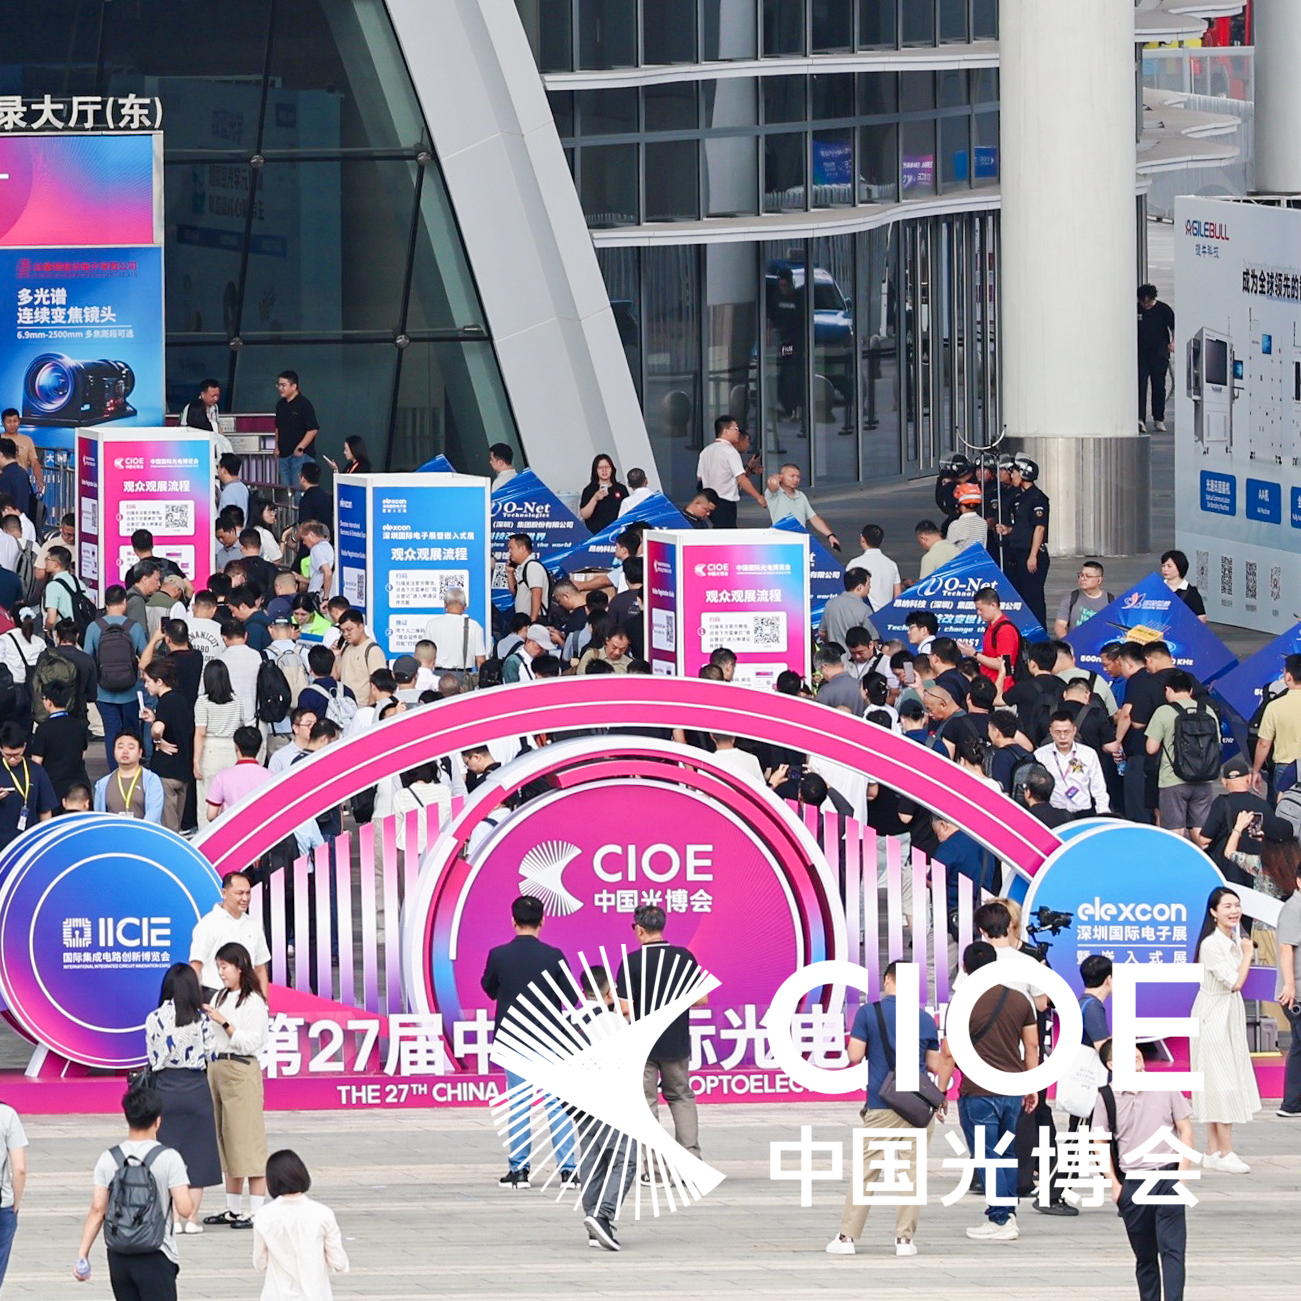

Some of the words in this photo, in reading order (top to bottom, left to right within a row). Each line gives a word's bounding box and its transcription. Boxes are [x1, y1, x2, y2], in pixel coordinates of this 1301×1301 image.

[17, 287, 67, 306] 多光谱
[17, 306, 117, 325] 连续变焦镜头
[123, 480, 190, 492] 观众观展流程
[503, 501, 551, 514] O-Net
[391, 547, 468, 561] 观众观展流程
[707, 563, 729, 572] CIOE
[944, 577, 998, 592] O-Net
[705, 589, 782, 603] 观众观展流程
[593, 843, 714, 883] CIOE
[593, 889, 713, 914] 中国光博会
[1077, 897, 1187, 922] elexcon
[98, 917, 171, 947] IICIE
[1076, 926, 1187, 941] 深圳国际电子展
[63, 951, 171, 963] 国际集成电路创新博览会
[337, 1084, 381, 1105] THE
[432, 1081, 500, 1102] CHINA
